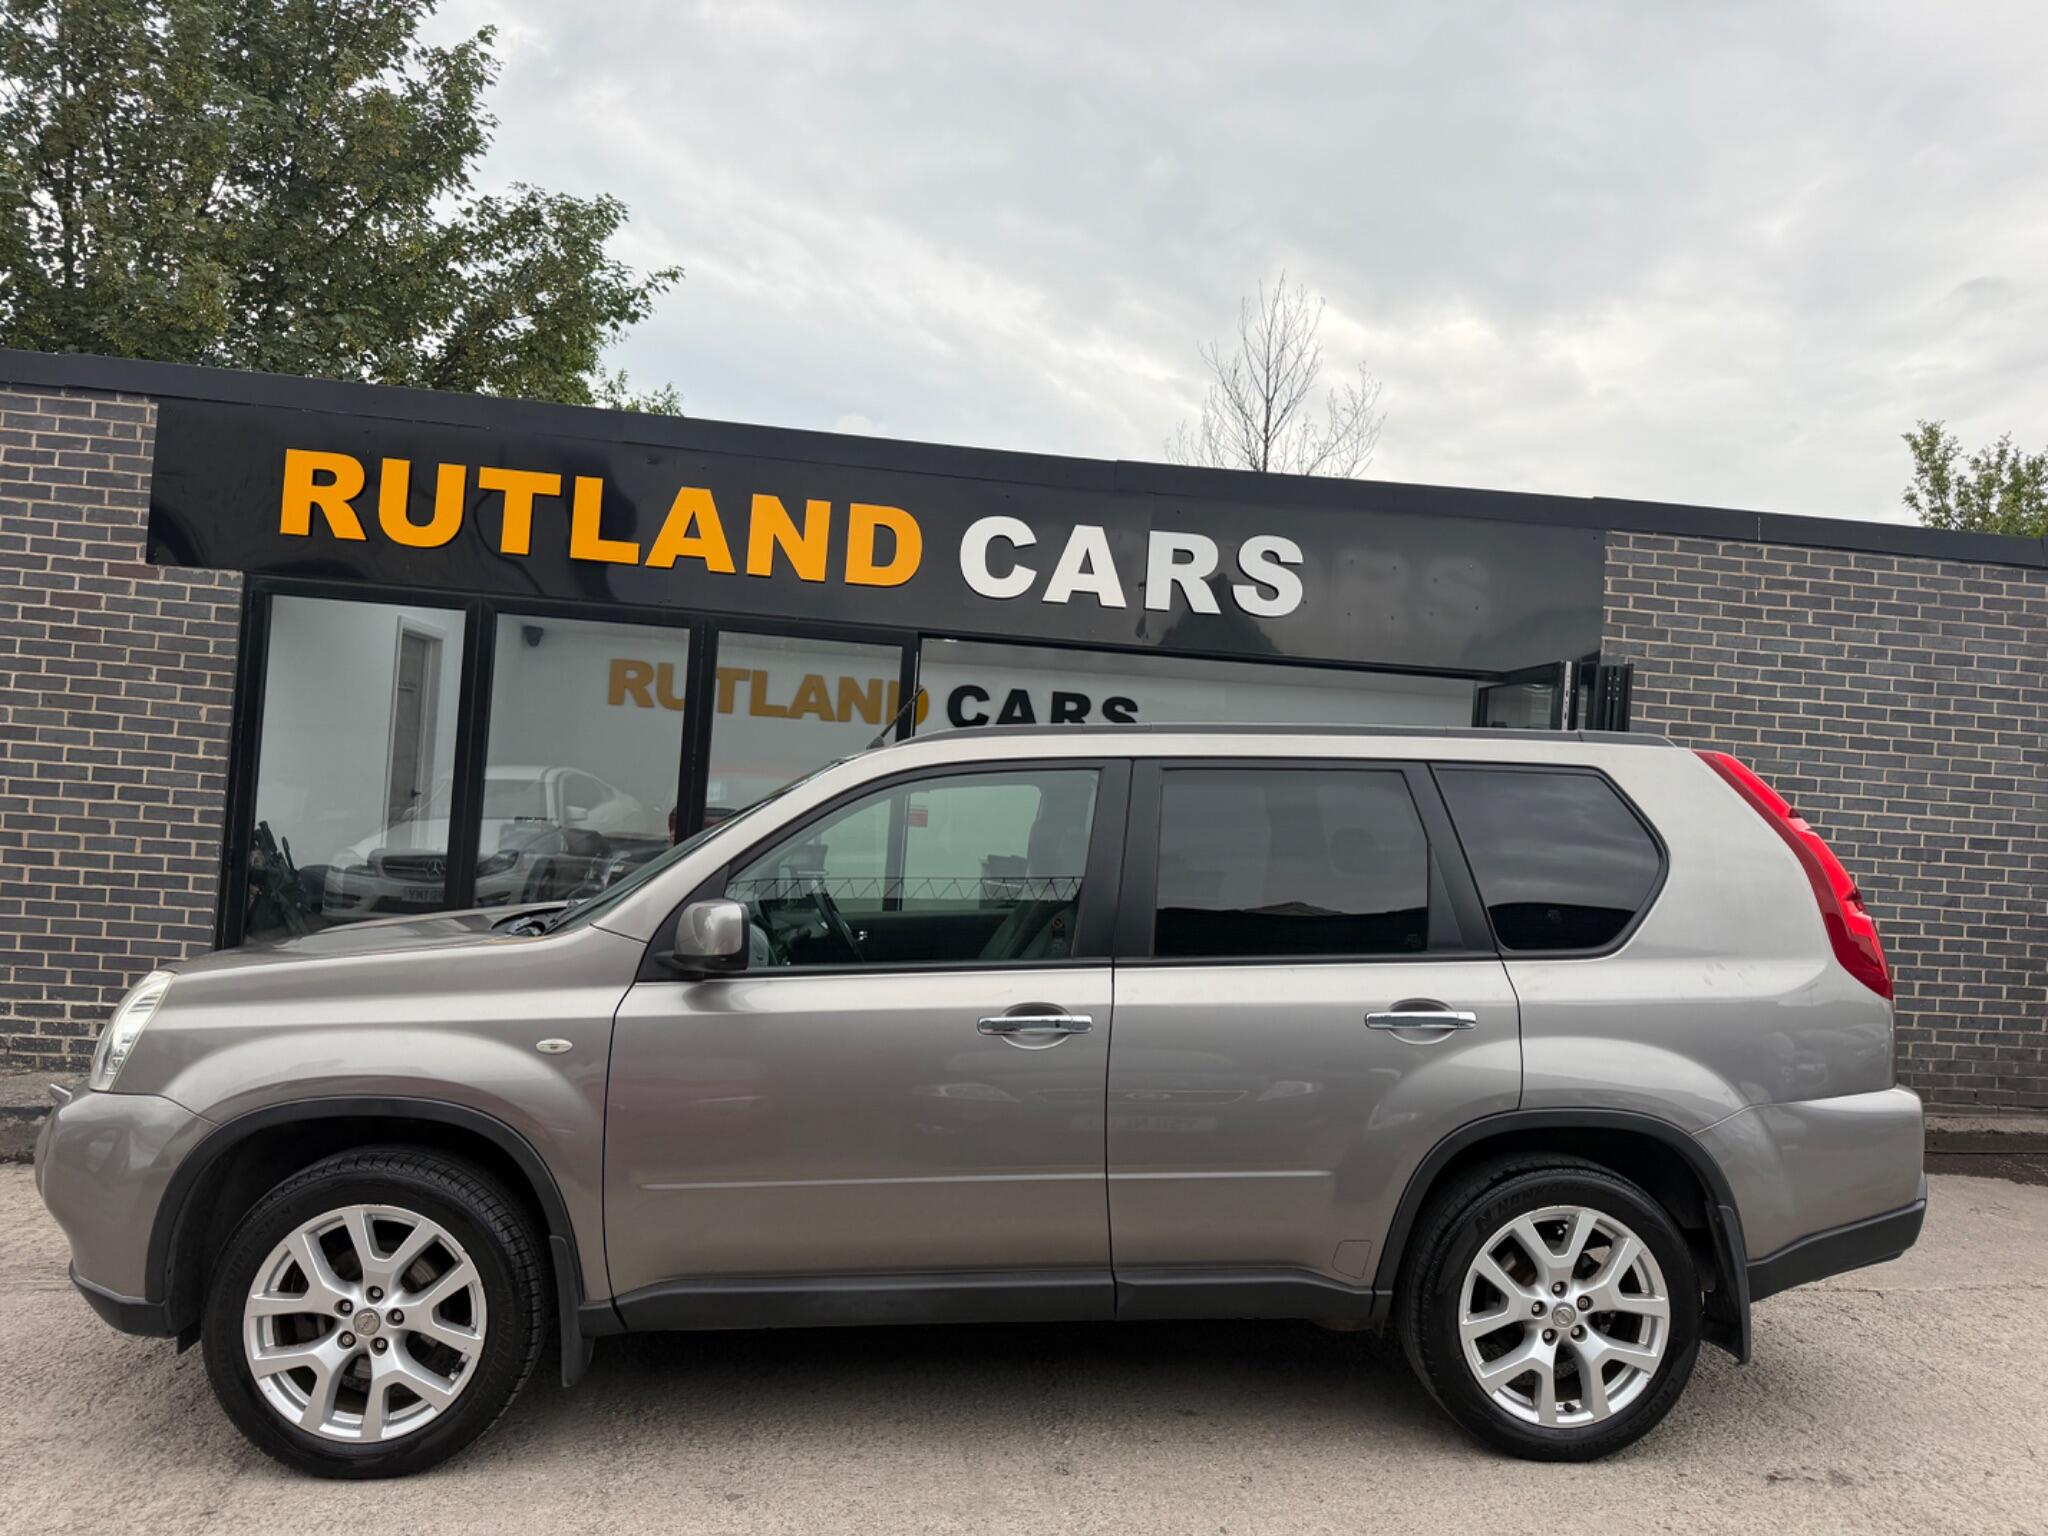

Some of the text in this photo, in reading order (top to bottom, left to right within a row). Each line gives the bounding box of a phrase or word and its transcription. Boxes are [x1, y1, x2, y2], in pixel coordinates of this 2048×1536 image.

[279, 448, 1304, 618] RUTLAND CARS
[947, 684, 1138, 727] CARS
